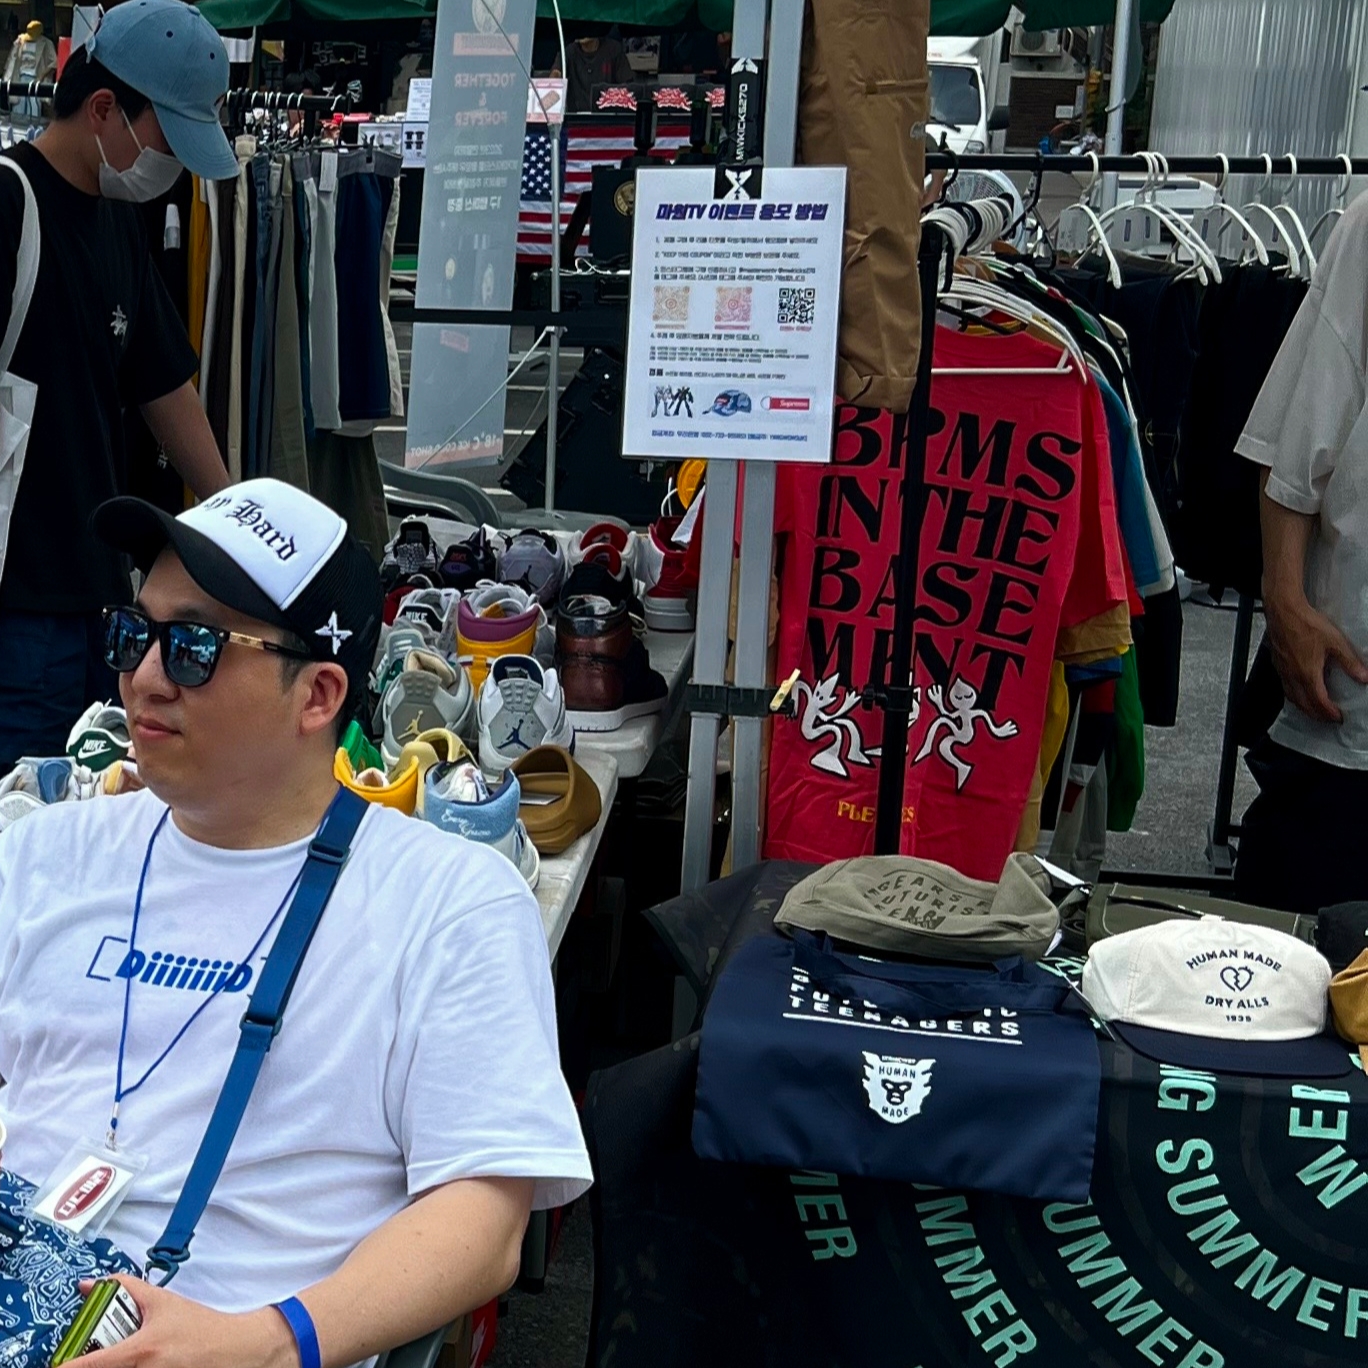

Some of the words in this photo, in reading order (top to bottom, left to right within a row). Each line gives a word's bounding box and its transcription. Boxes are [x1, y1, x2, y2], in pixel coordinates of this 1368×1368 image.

[708, 203, 758, 220] 이벤트
[814, 475, 889, 543] IN
[809, 544, 1040, 647] BASE
[406, 611, 428, 623] NIKE
[82, 738, 107, 752] NIKE
[1185, 949, 1238, 970] HUMAN
[1243, 950, 1283, 972] MADE
[1205, 995, 1234, 1009] DRY
[1236, 996, 1270, 1009] ALLS
[789, 994, 1020, 1036] TEENAGERS
[878, 1065, 917, 1079] HUMAN
[881, 1106, 909, 1118] MADE
